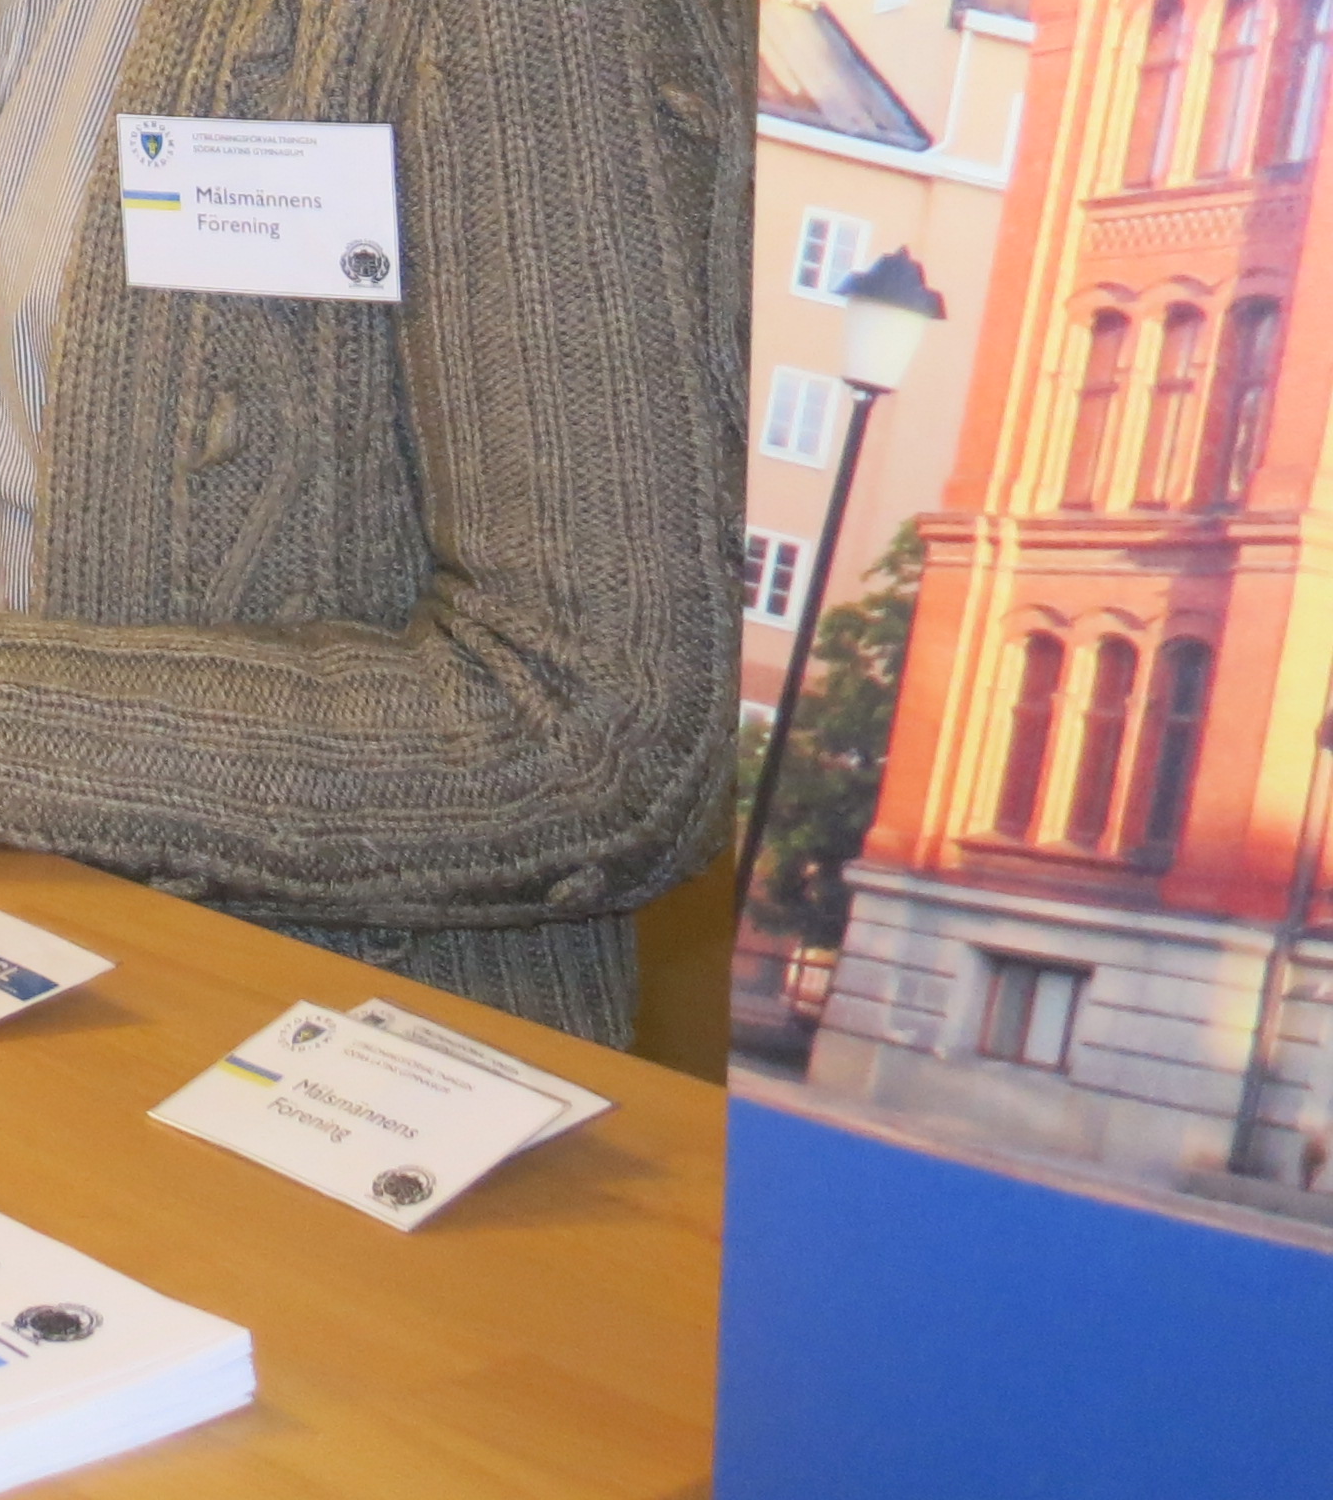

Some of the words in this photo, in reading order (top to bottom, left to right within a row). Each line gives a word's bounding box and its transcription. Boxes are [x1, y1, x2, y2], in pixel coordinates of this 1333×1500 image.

[252, 147, 305, 157] GYMNASIUM
[195, 185, 323, 209] Målsmännens
[196, 212, 281, 240] Förening
[267, 1096, 352, 1144] Förening
[291, 1077, 419, 1141] Målsmännens
